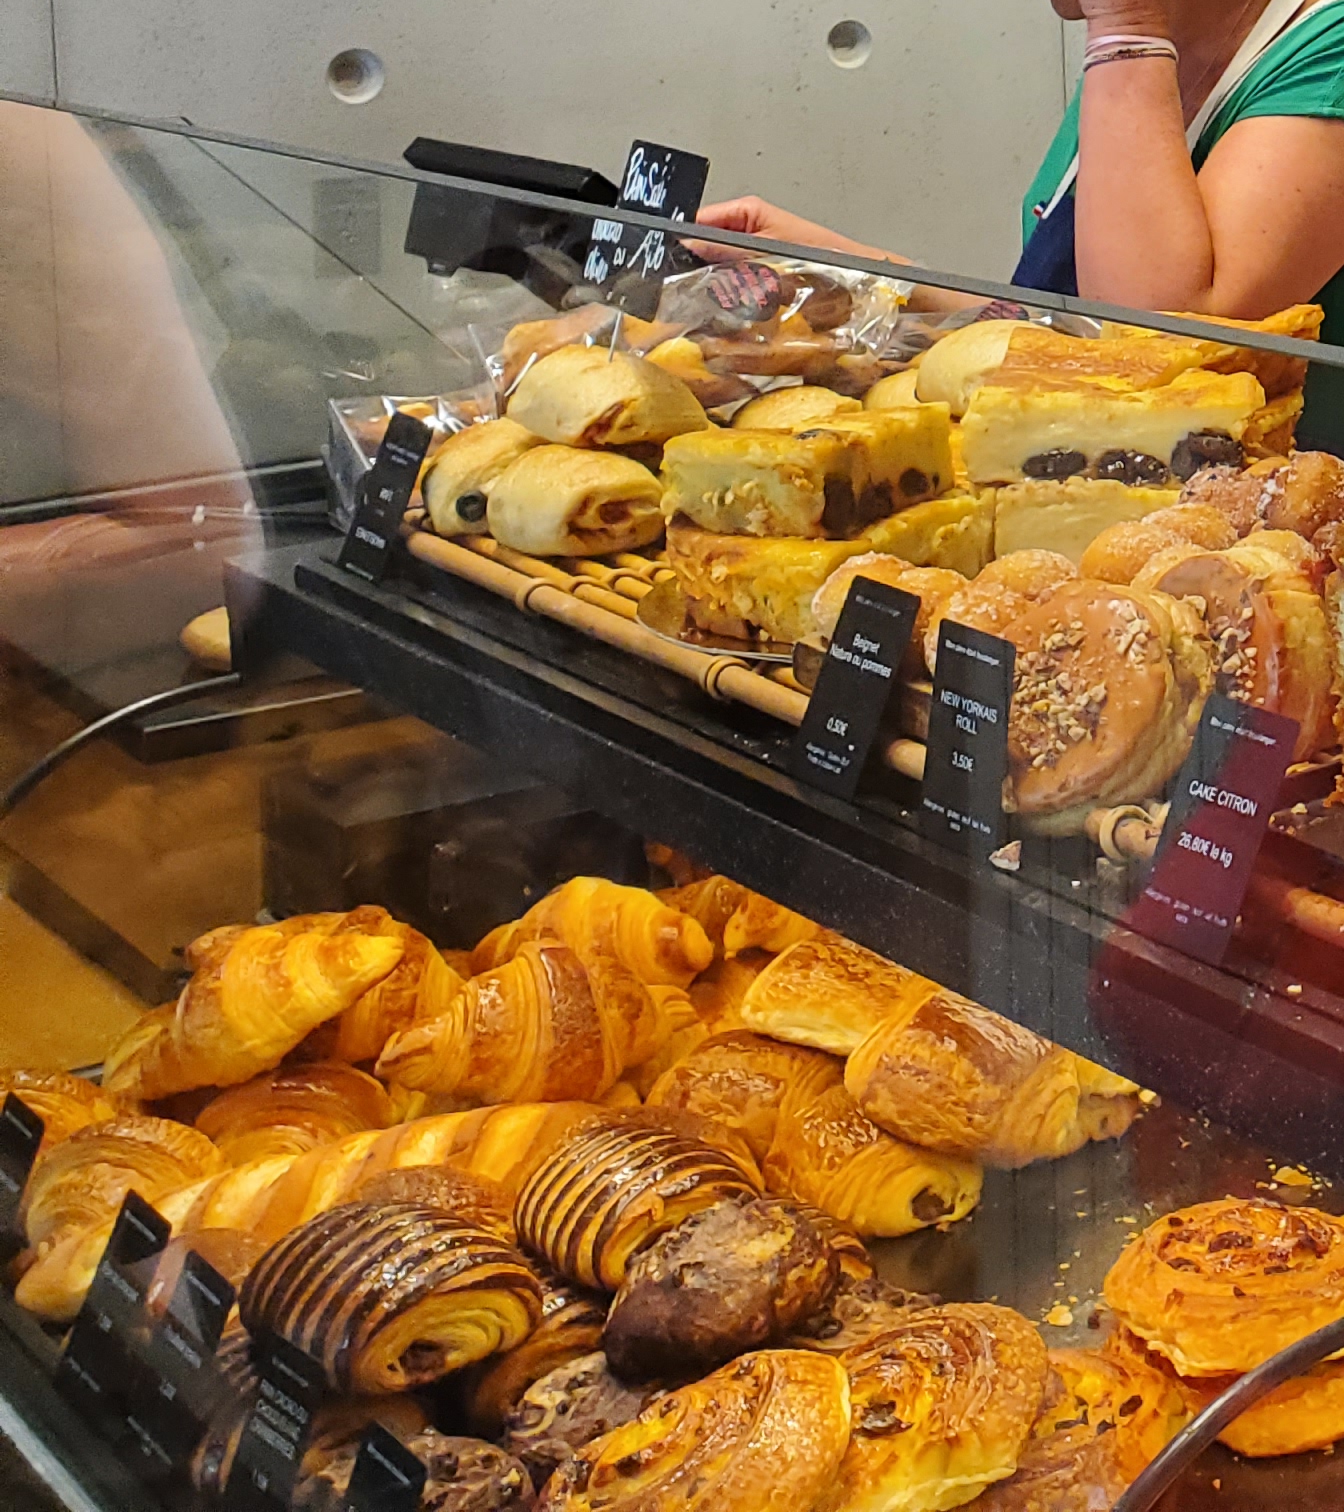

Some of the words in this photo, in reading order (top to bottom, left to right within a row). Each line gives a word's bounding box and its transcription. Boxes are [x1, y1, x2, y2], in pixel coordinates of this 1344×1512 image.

[940, 688, 961, 709] NEW
[961, 697, 998, 724] YORKAIS
[955, 714, 978, 736] ROLL
[1188, 779, 1219, 805] CAKE
[1217, 789, 1259, 818] CITRON
[1220, 847, 1233, 869] kg
